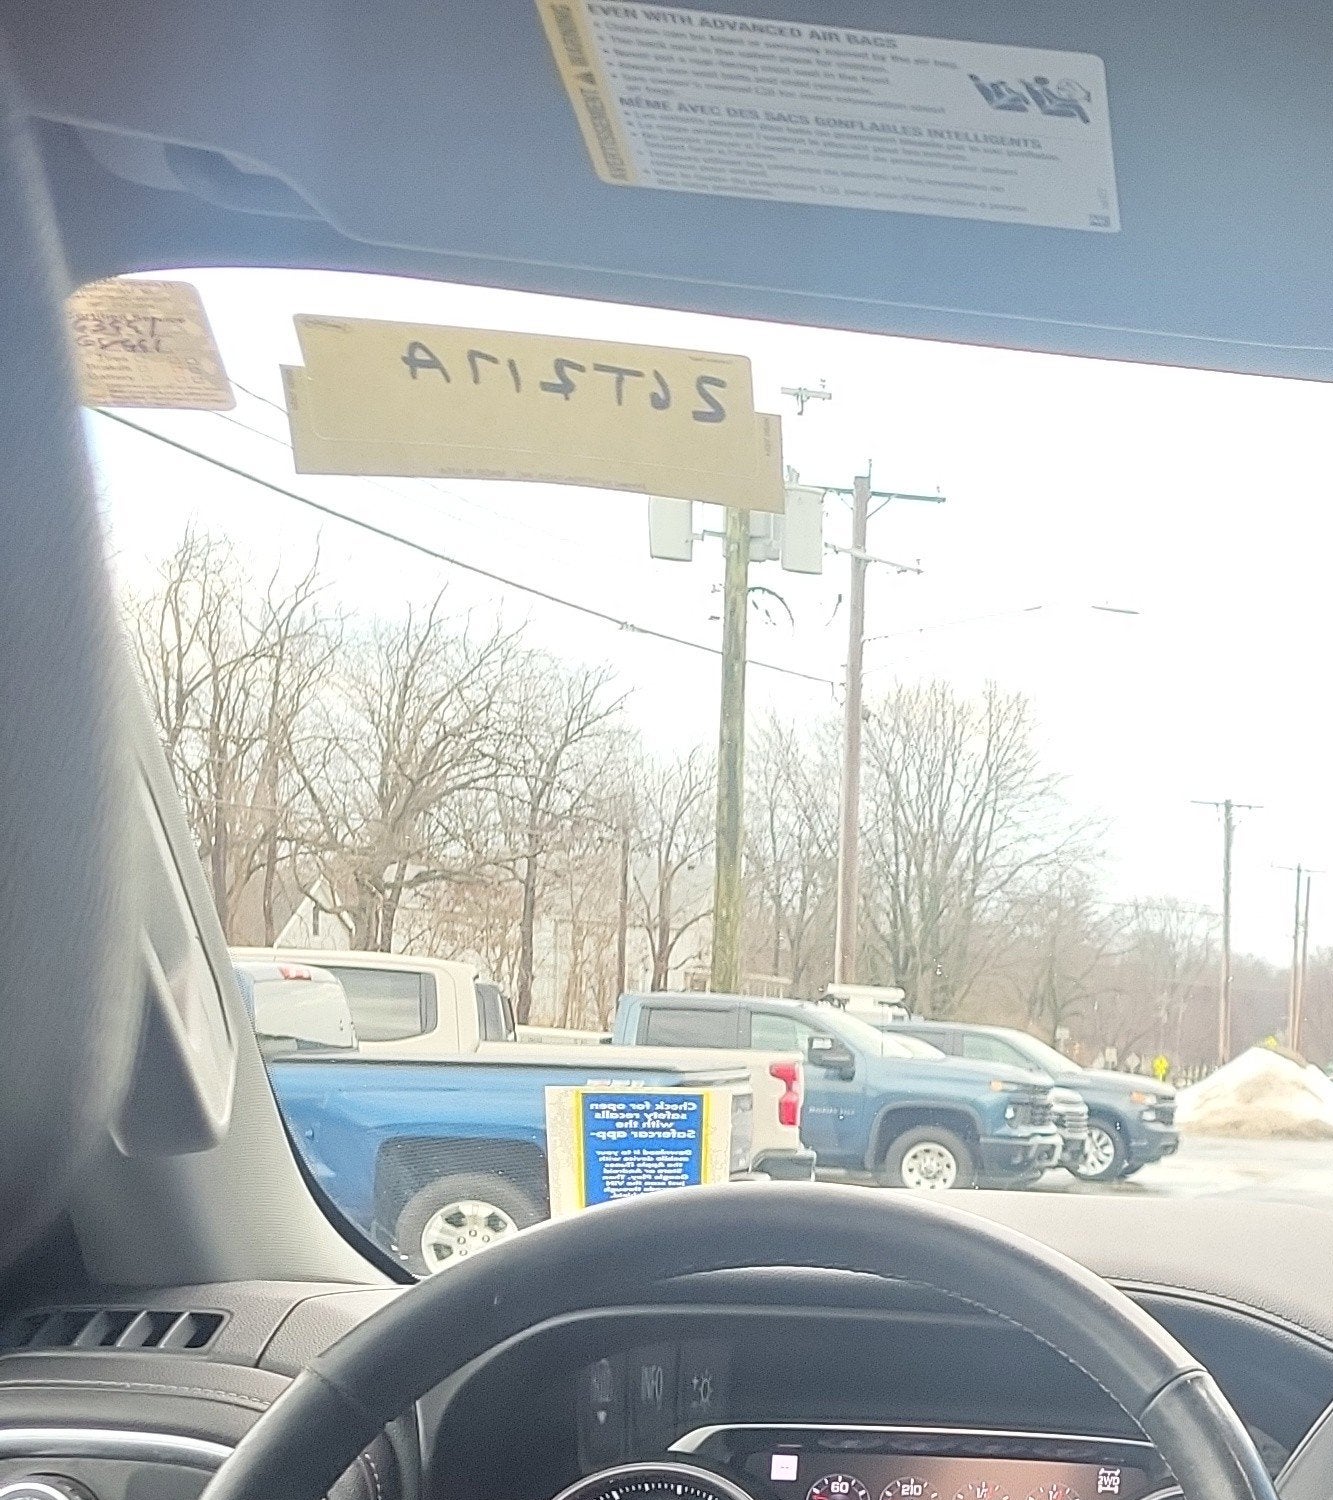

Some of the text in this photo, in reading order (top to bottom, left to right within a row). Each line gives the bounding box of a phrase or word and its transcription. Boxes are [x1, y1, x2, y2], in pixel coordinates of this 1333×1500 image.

[587, 2, 898, 49] EVEN WITH ADVANCED AIR BAGS
[677, 100, 720, 115] AVEC
[726, 105, 760, 120] DES
[764, 110, 810, 126] SACS
[814, 116, 923, 137] GONFLABLES
[927, 128, 1043, 150] INTELLIGENTS
[830, 1481, 850, 1494] 60
[1097, 1475, 1121, 1487] 2WD
[901, 1484, 923, 1497] 210
